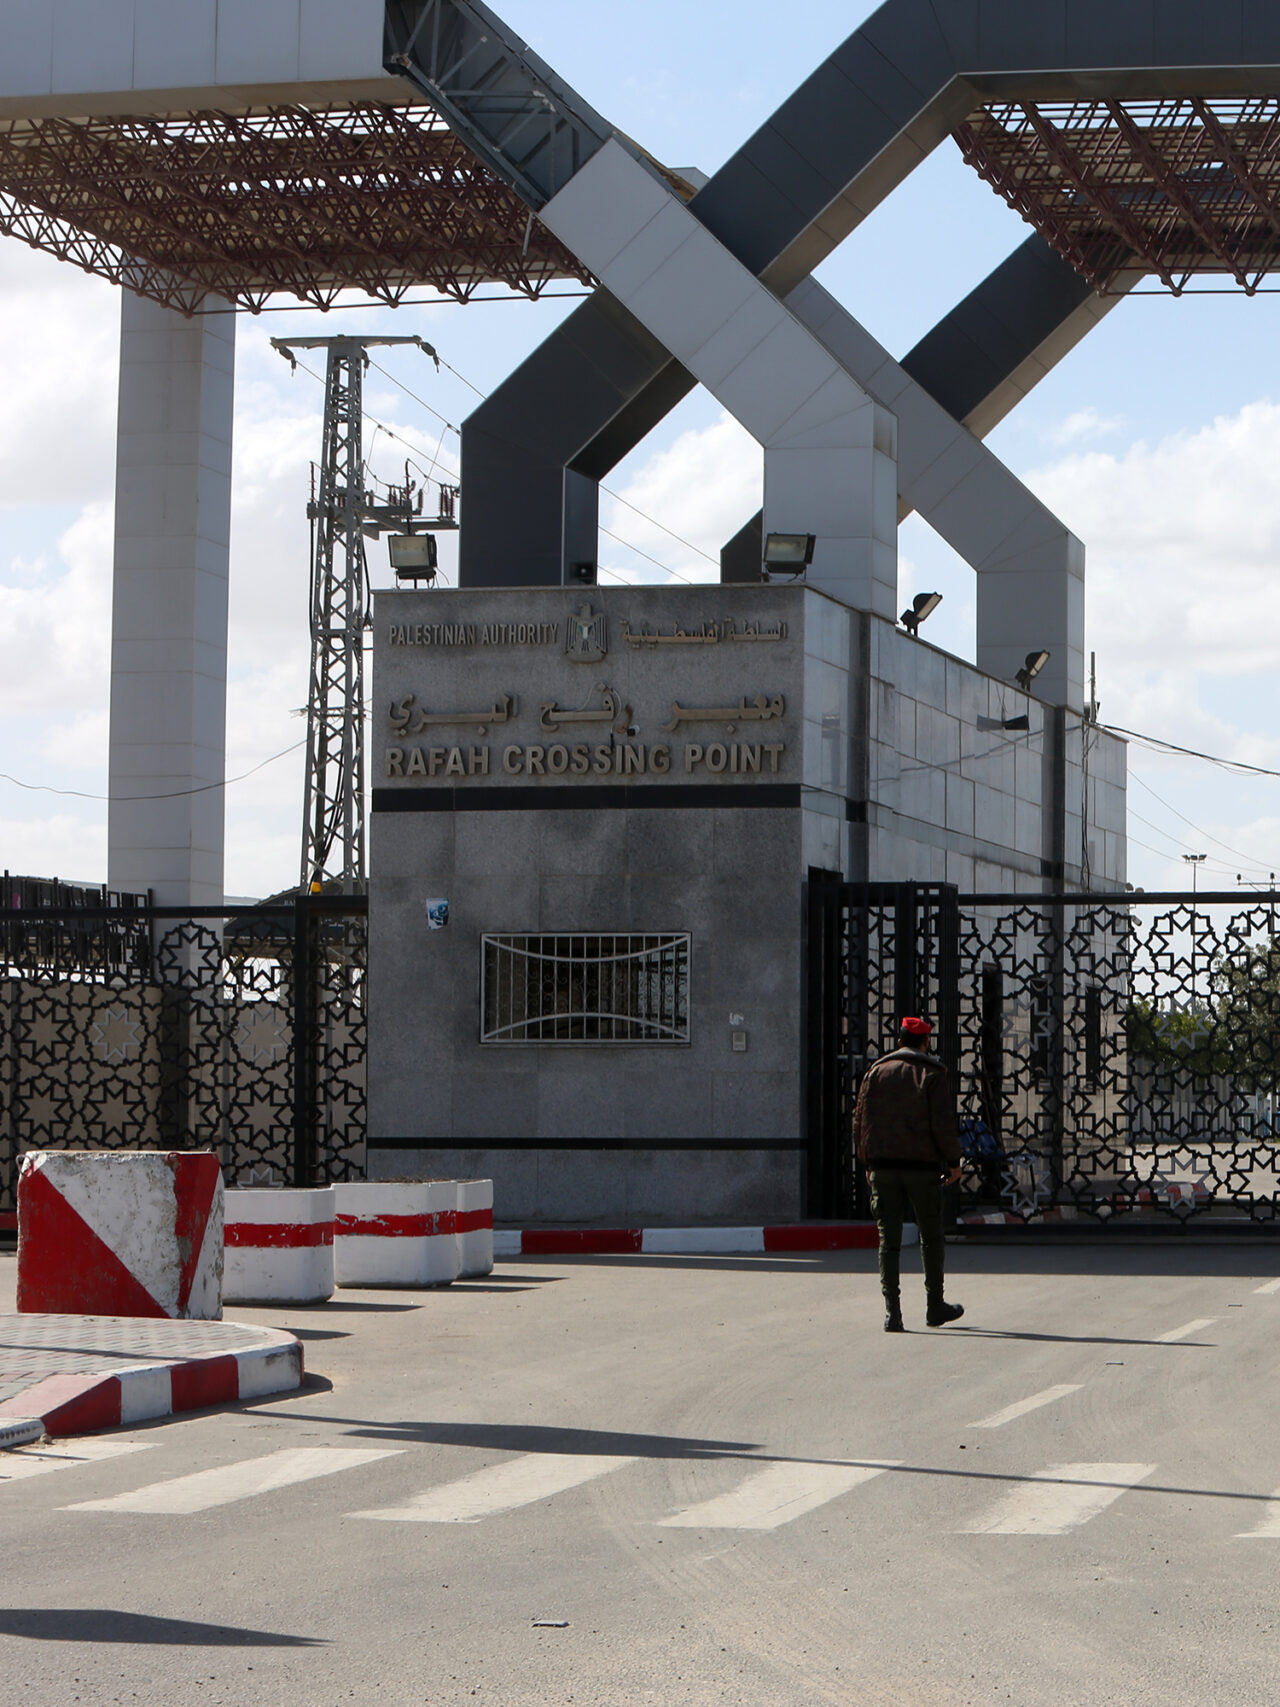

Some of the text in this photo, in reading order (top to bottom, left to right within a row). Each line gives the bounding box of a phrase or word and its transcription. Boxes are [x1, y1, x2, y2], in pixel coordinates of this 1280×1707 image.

[388, 622, 559, 646] PALESTINIAN AUTHORITY
[619, 616, 788, 650] السلطة الفلسطينية
[386, 682, 786, 738] معبر رفح البري
[384, 742, 785, 778] RAFAH CROSSING POINT
